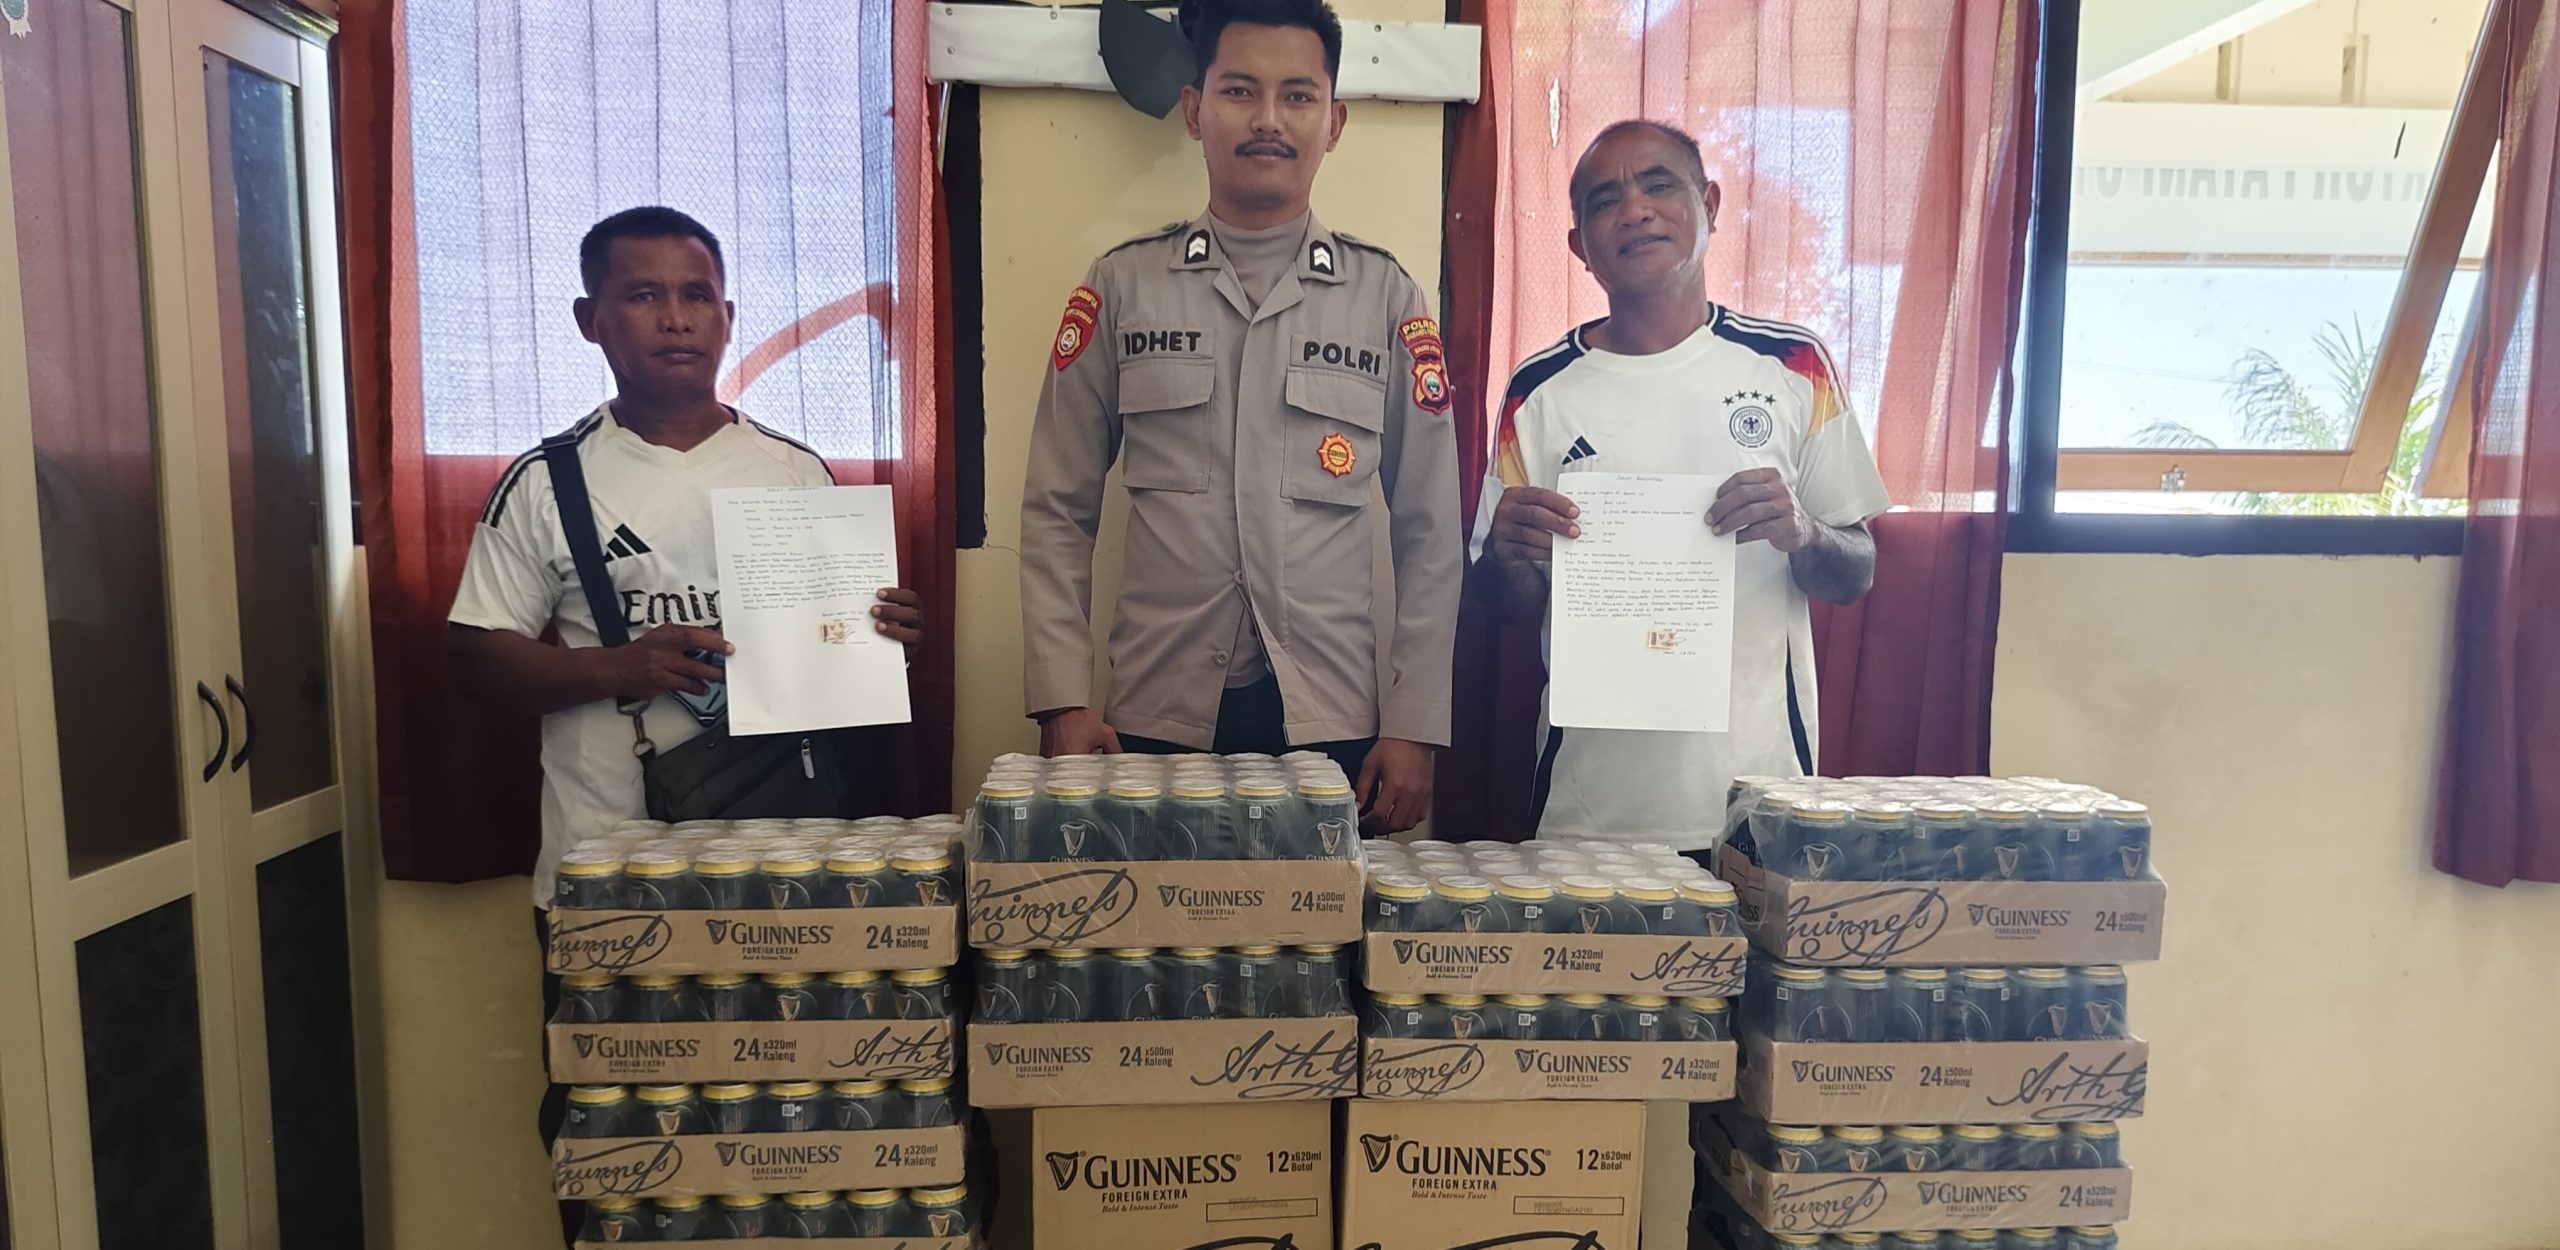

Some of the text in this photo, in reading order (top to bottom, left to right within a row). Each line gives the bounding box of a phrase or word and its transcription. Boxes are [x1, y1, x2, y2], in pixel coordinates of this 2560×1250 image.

[1124, 330, 1202, 356] IDHET
[1303, 341, 1381, 376] POLRI
[1178, 888, 1264, 907] GUINNESS
[1291, 891, 1346, 912] 24 x500ml
[1315, 903, 1344, 913] Kaleng
[1986, 907, 2068, 927] GUINNESS
[2094, 911, 2117, 932] 24
[730, 922, 832, 945] GUINNESS
[866, 925, 930, 949] 24 x320ml
[896, 938, 929, 949] Kaleng
[1416, 942, 1510, 964] GUINNESS
[1542, 947, 1604, 970] 24 x320ml
[1570, 960, 1601, 972] Kaleng
[597, 1037, 698, 1058] GUINNESS
[733, 1038, 797, 1062] 24 x320ml
[763, 1051, 796, 1062] Kaleng
[1006, 1045, 1091, 1064] GUINNESS
[1119, 1046, 1174, 1067] 24 x500ml
[1145, 1057, 1173, 1067] Kaleng
[1536, 1052, 1629, 1074] GUINNESS
[1660, 1057, 1720, 1080] 24 x320ml
[1811, 1063, 1893, 1082] GUINNESS
[1688, 1070, 1718, 1081] Kaleng
[1919, 1066, 1942, 1087] 24
[740, 1144, 840, 1166] GUINNESS
[875, 1144, 938, 1167] 24 x320ml
[904, 1156, 936, 1168] Kaleng
[1266, 1151, 1322, 1173] 12 x620ml
[1396, 1140, 1546, 1177] GUINNESS
[1576, 1148, 1632, 1170] 12 x620ml
[1601, 1161, 1622, 1170] Botol
[1084, 1153, 1237, 1189] GUINNESS
[1291, 1162, 1313, 1171] Botol
[1412, 1178, 1497, 1190] FOREIGN EXTRA
[1937, 1183, 2028, 1204] GUINNESS
[1102, 1188, 1188, 1203] FOREIGN EXTRA
[2058, 1185, 2083, 1207] 24
